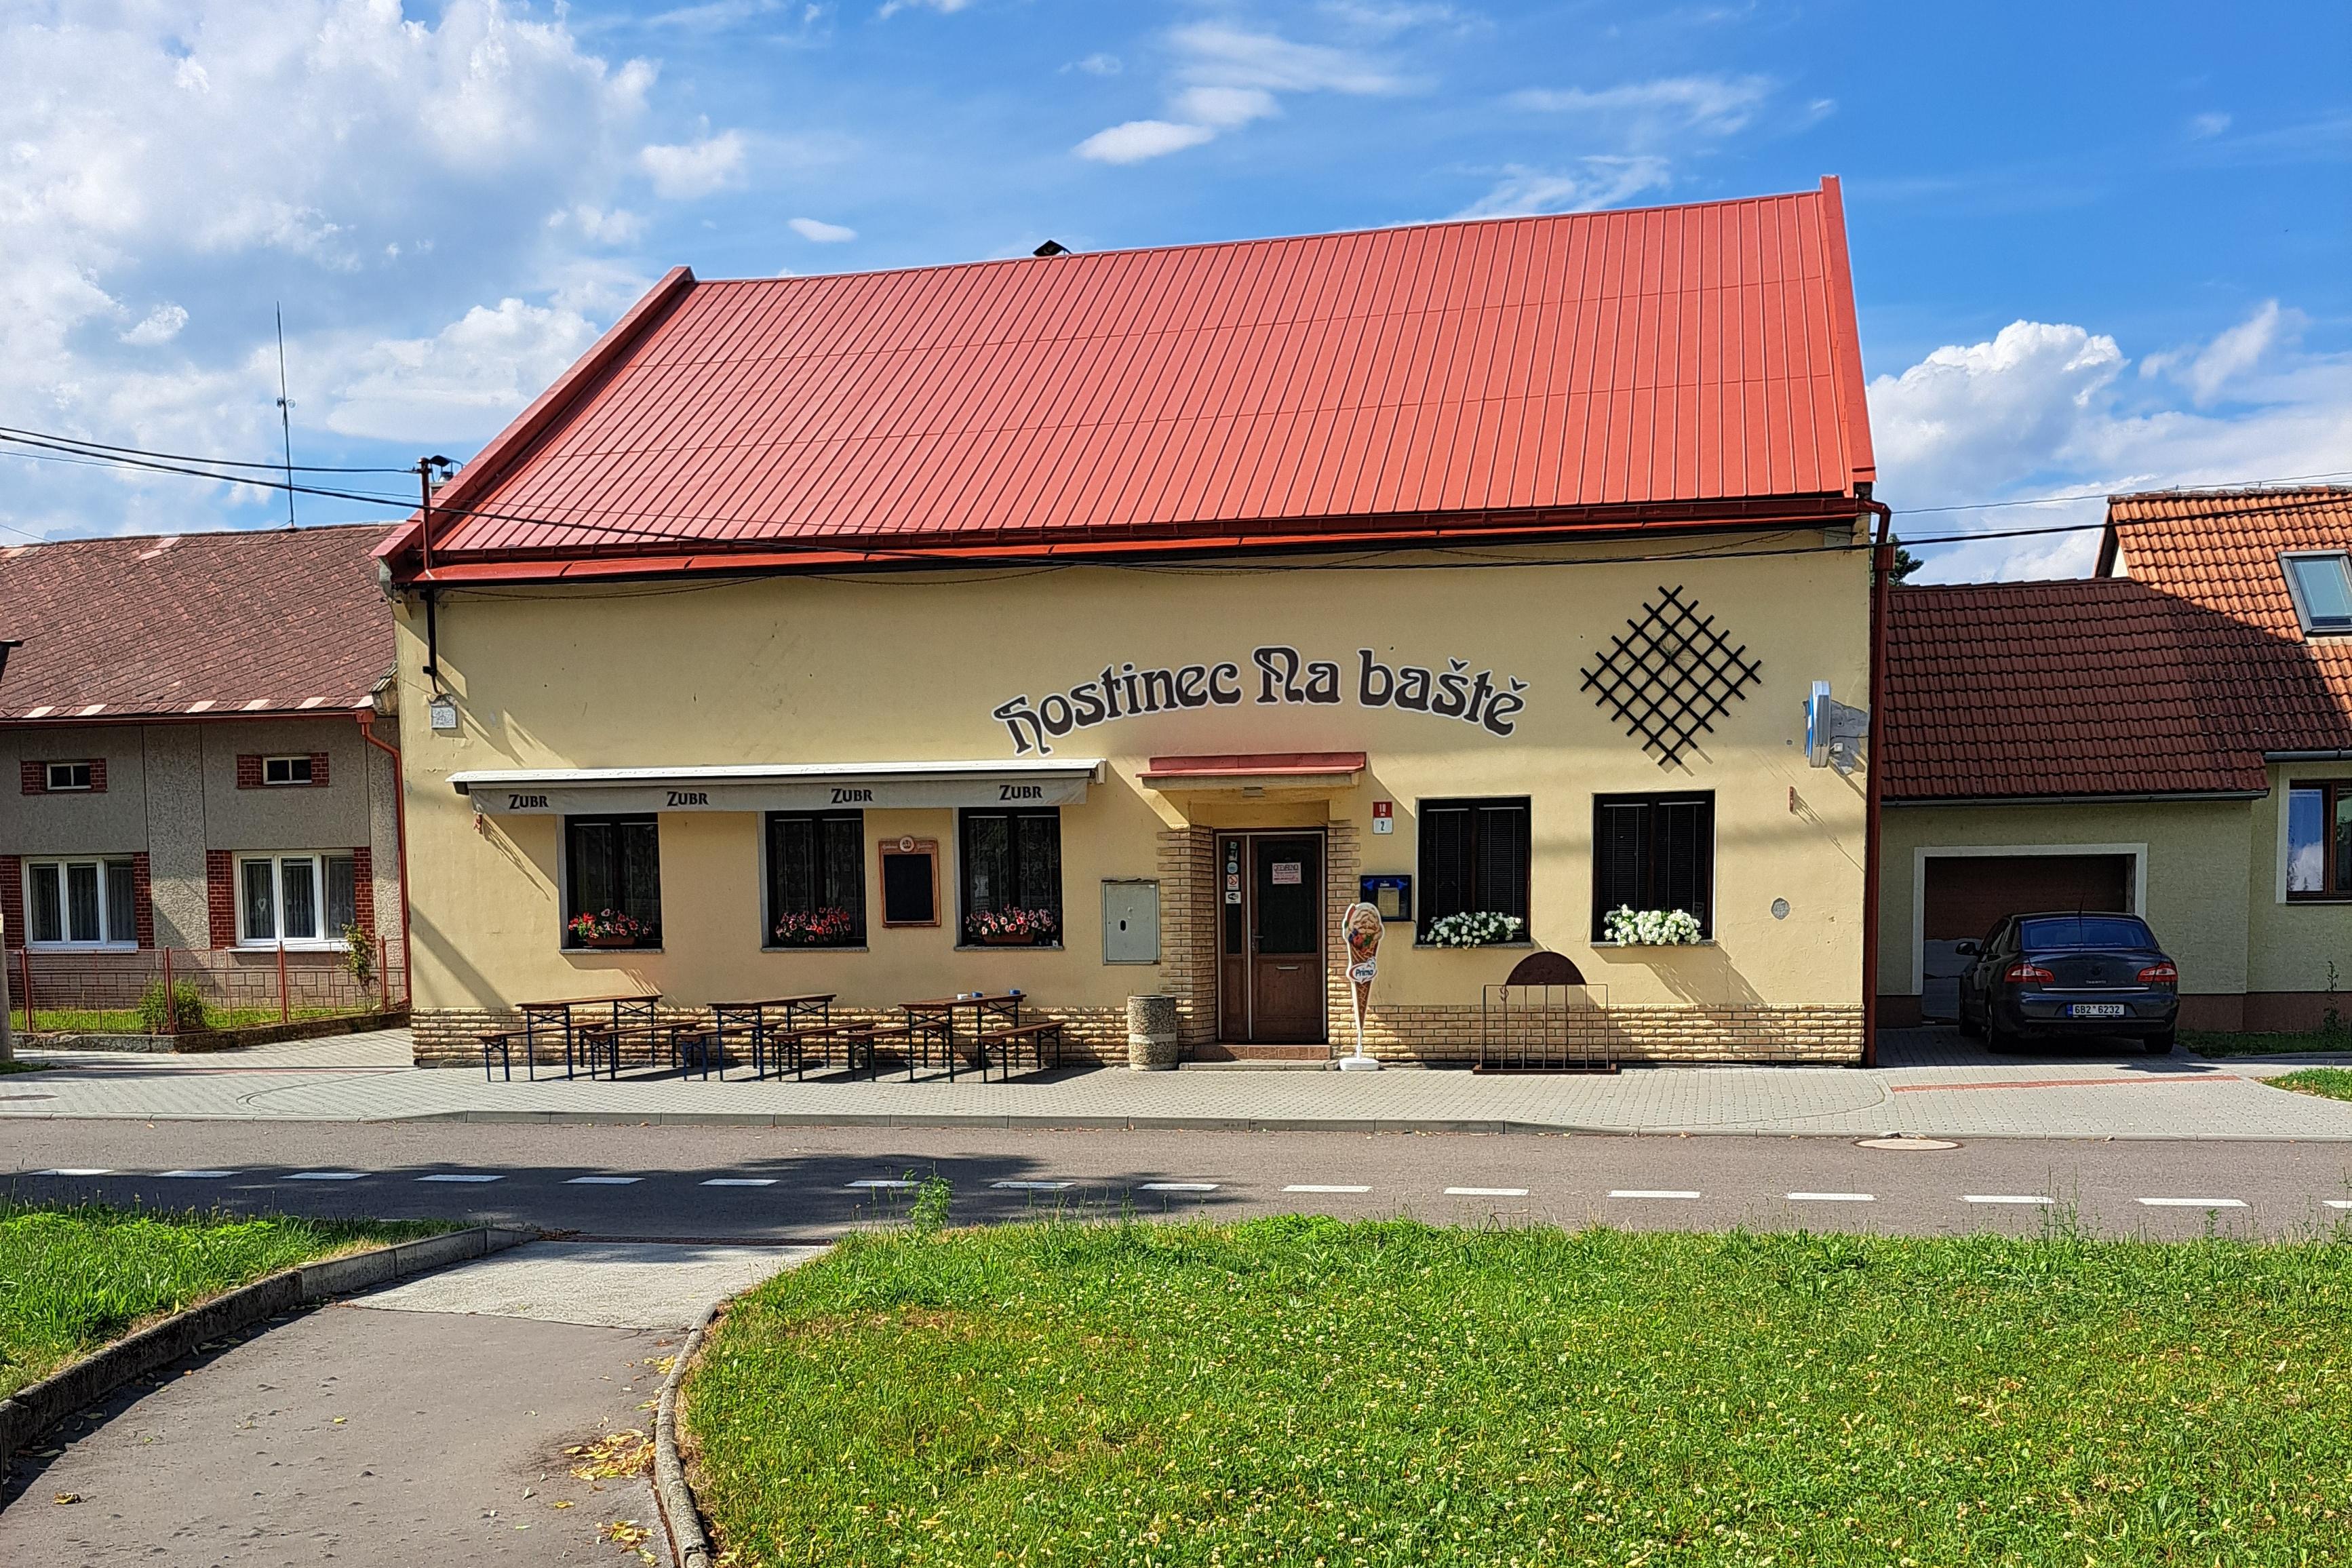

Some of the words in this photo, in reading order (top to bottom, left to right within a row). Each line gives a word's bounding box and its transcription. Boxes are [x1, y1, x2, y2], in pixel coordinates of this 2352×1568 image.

[1252, 646, 1341, 705] Na
[1357, 647, 1529, 738] baště
[667, 791, 709, 806] ZUBR
[831, 788, 874, 804] ZUBR
[1000, 785, 1043, 800] ZUBR
[509, 793, 549, 810] ZUBR
[1355, 968, 1373, 977] Prima
[2075, 1005, 2092, 1014] 6B2
[2098, 1005, 2120, 1014] 6232
